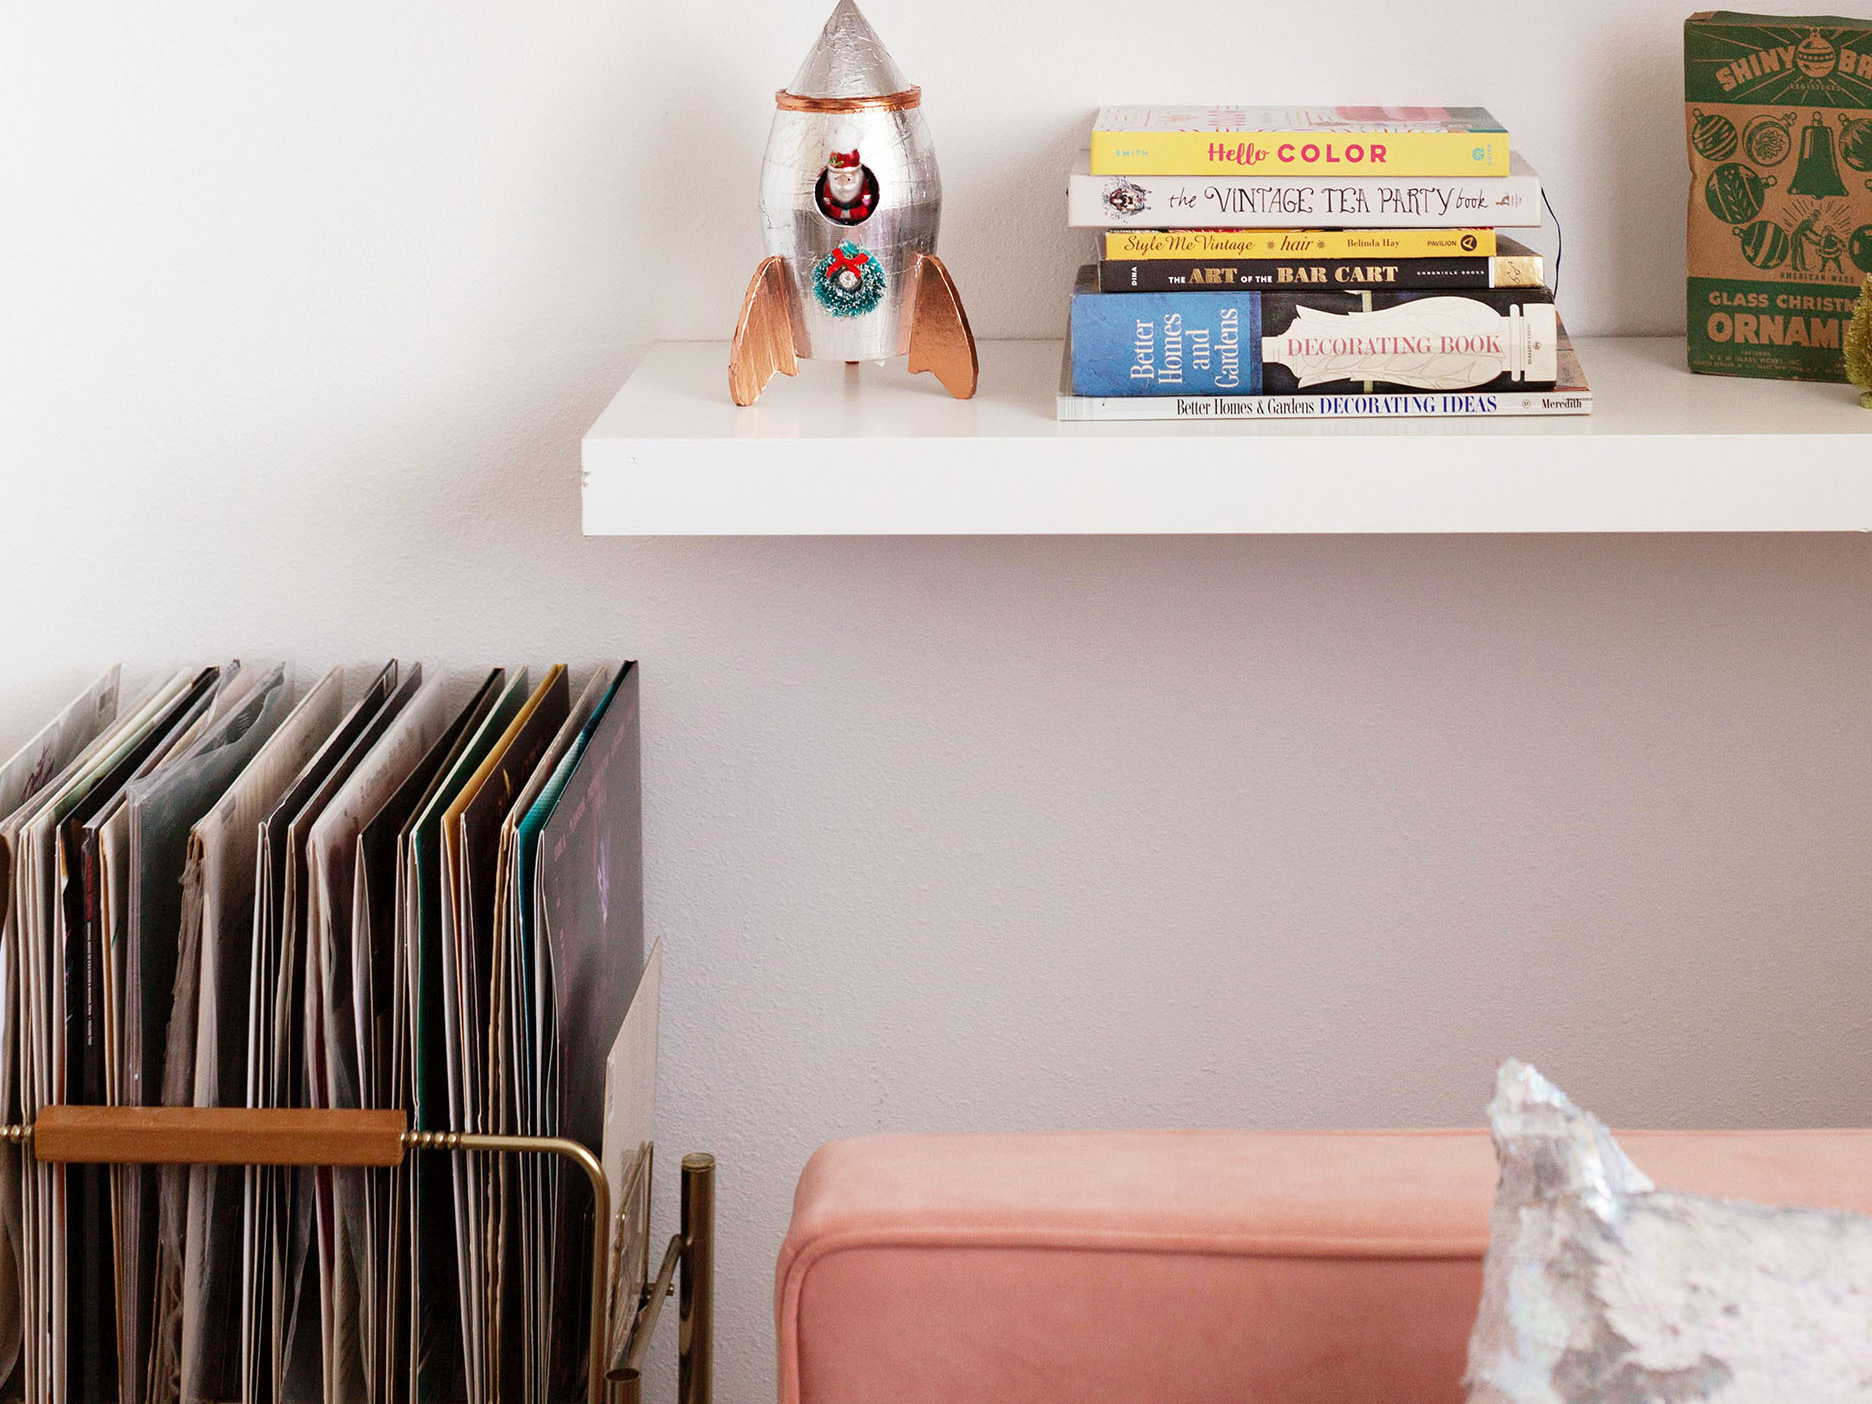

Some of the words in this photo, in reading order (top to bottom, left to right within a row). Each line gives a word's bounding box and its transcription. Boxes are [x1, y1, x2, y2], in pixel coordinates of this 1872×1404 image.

[1715, 45, 1796, 92] SHINY
[1208, 142, 1270, 165] Hello
[1278, 143, 1387, 163] COLOR
[1168, 187, 1196, 208] the
[1204, 186, 1314, 213] VINTAGE
[1321, 187, 1370, 213] TEA
[1378, 187, 1455, 216] PARTY
[1456, 188, 1489, 210] book
[1124, 235, 1164, 256] Style
[1164, 235, 1195, 251] Me
[1195, 235, 1255, 256] Vintage
[1280, 236, 1313, 251] hair
[1347, 238, 1381, 248] Belinda
[1382, 238, 1400, 249] Hay
[1168, 276, 1186, 284] THE
[1187, 268, 1238, 284] ART
[1276, 267, 1328, 283] BAR
[1334, 266, 1399, 282] CART
[1708, 291, 1769, 308] GLASS
[1707, 311, 1851, 349] ORNAM
[1130, 318, 1155, 380] Better
[1158, 312, 1183, 384] Homes
[1185, 328, 1210, 370] and
[1214, 307, 1240, 388] Gardens
[1287, 335, 1431, 357] DECORATING
[1441, 334, 1501, 355] BOOK
[1177, 399, 1211, 415] Better
[1214, 398, 1253, 415] Homes
[1256, 399, 1265, 414] &
[1267, 397, 1315, 414] Gardens
[1320, 395, 1435, 414] DECORATING
[1442, 395, 1498, 413] IDEAS
[1541, 398, 1582, 410] Meredith
